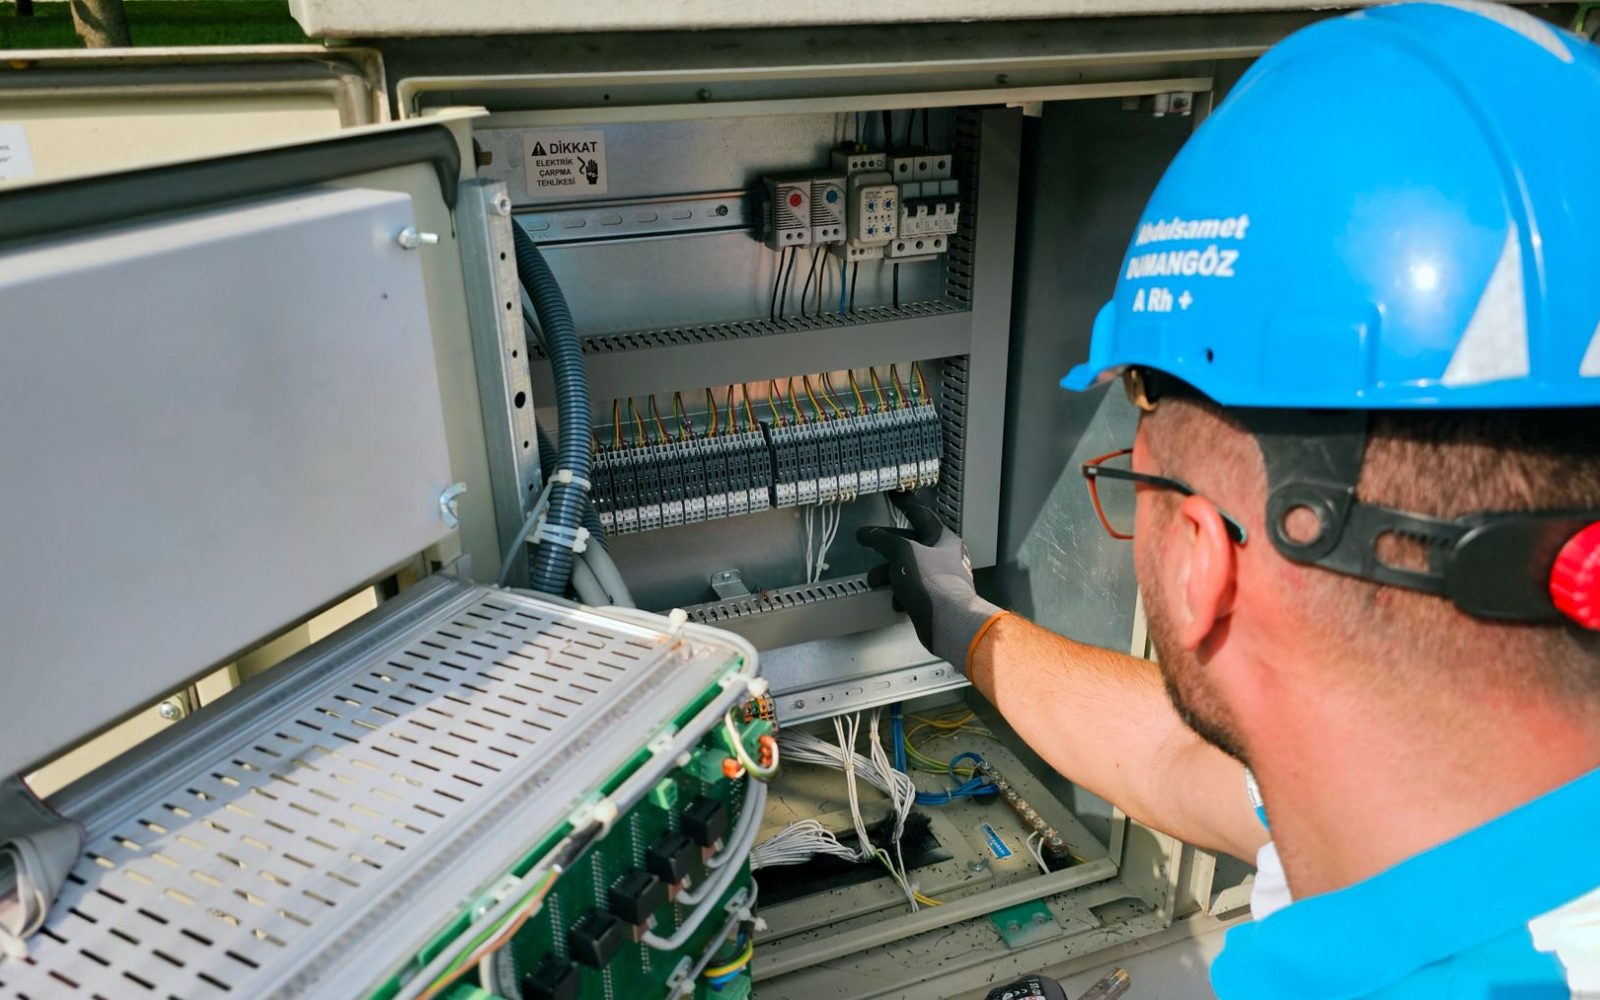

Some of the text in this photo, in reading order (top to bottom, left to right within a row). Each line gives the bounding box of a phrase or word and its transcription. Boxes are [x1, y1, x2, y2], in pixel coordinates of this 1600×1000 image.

[549, 139, 598, 154] DİKKAT
[536, 157, 573, 167] ELEKTRİK
[539, 168, 572, 177] ÇARPMA
[537, 177, 576, 187] TEHLİKESİ
[1132, 288, 1145, 312] A
[1147, 287, 1174, 312] Rh
